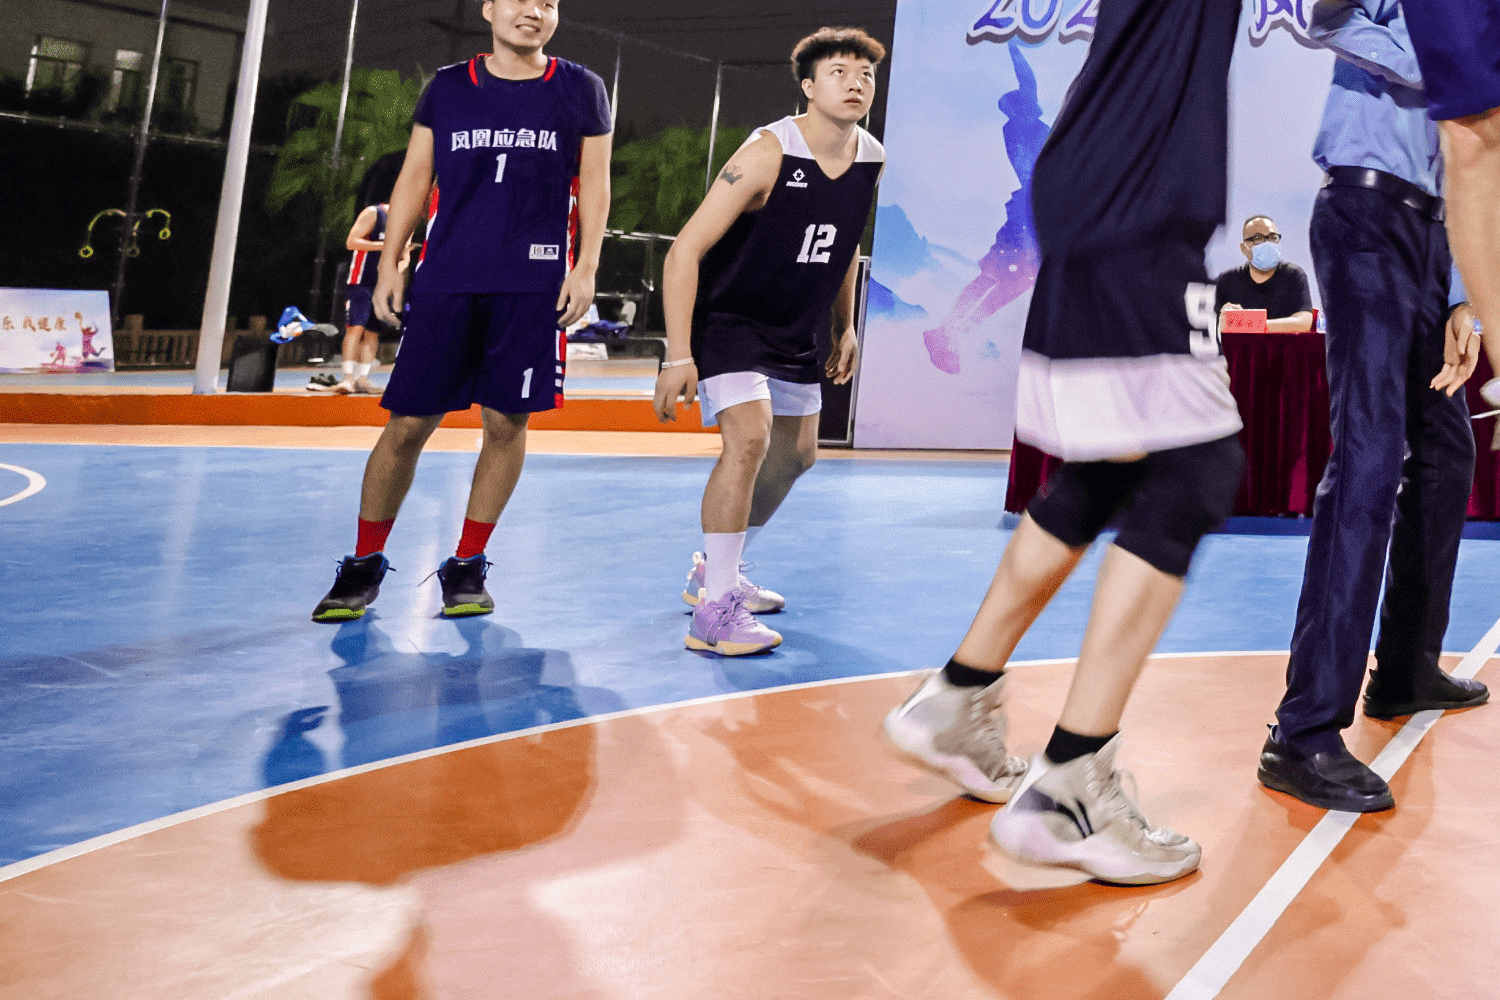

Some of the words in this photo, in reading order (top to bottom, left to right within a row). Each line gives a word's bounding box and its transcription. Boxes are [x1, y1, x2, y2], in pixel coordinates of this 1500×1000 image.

[451, 128, 557, 152] 凤凰应急队
[495, 153, 507, 183] 1
[796, 224, 837, 263] 12
[521, 367, 533, 398] 1
